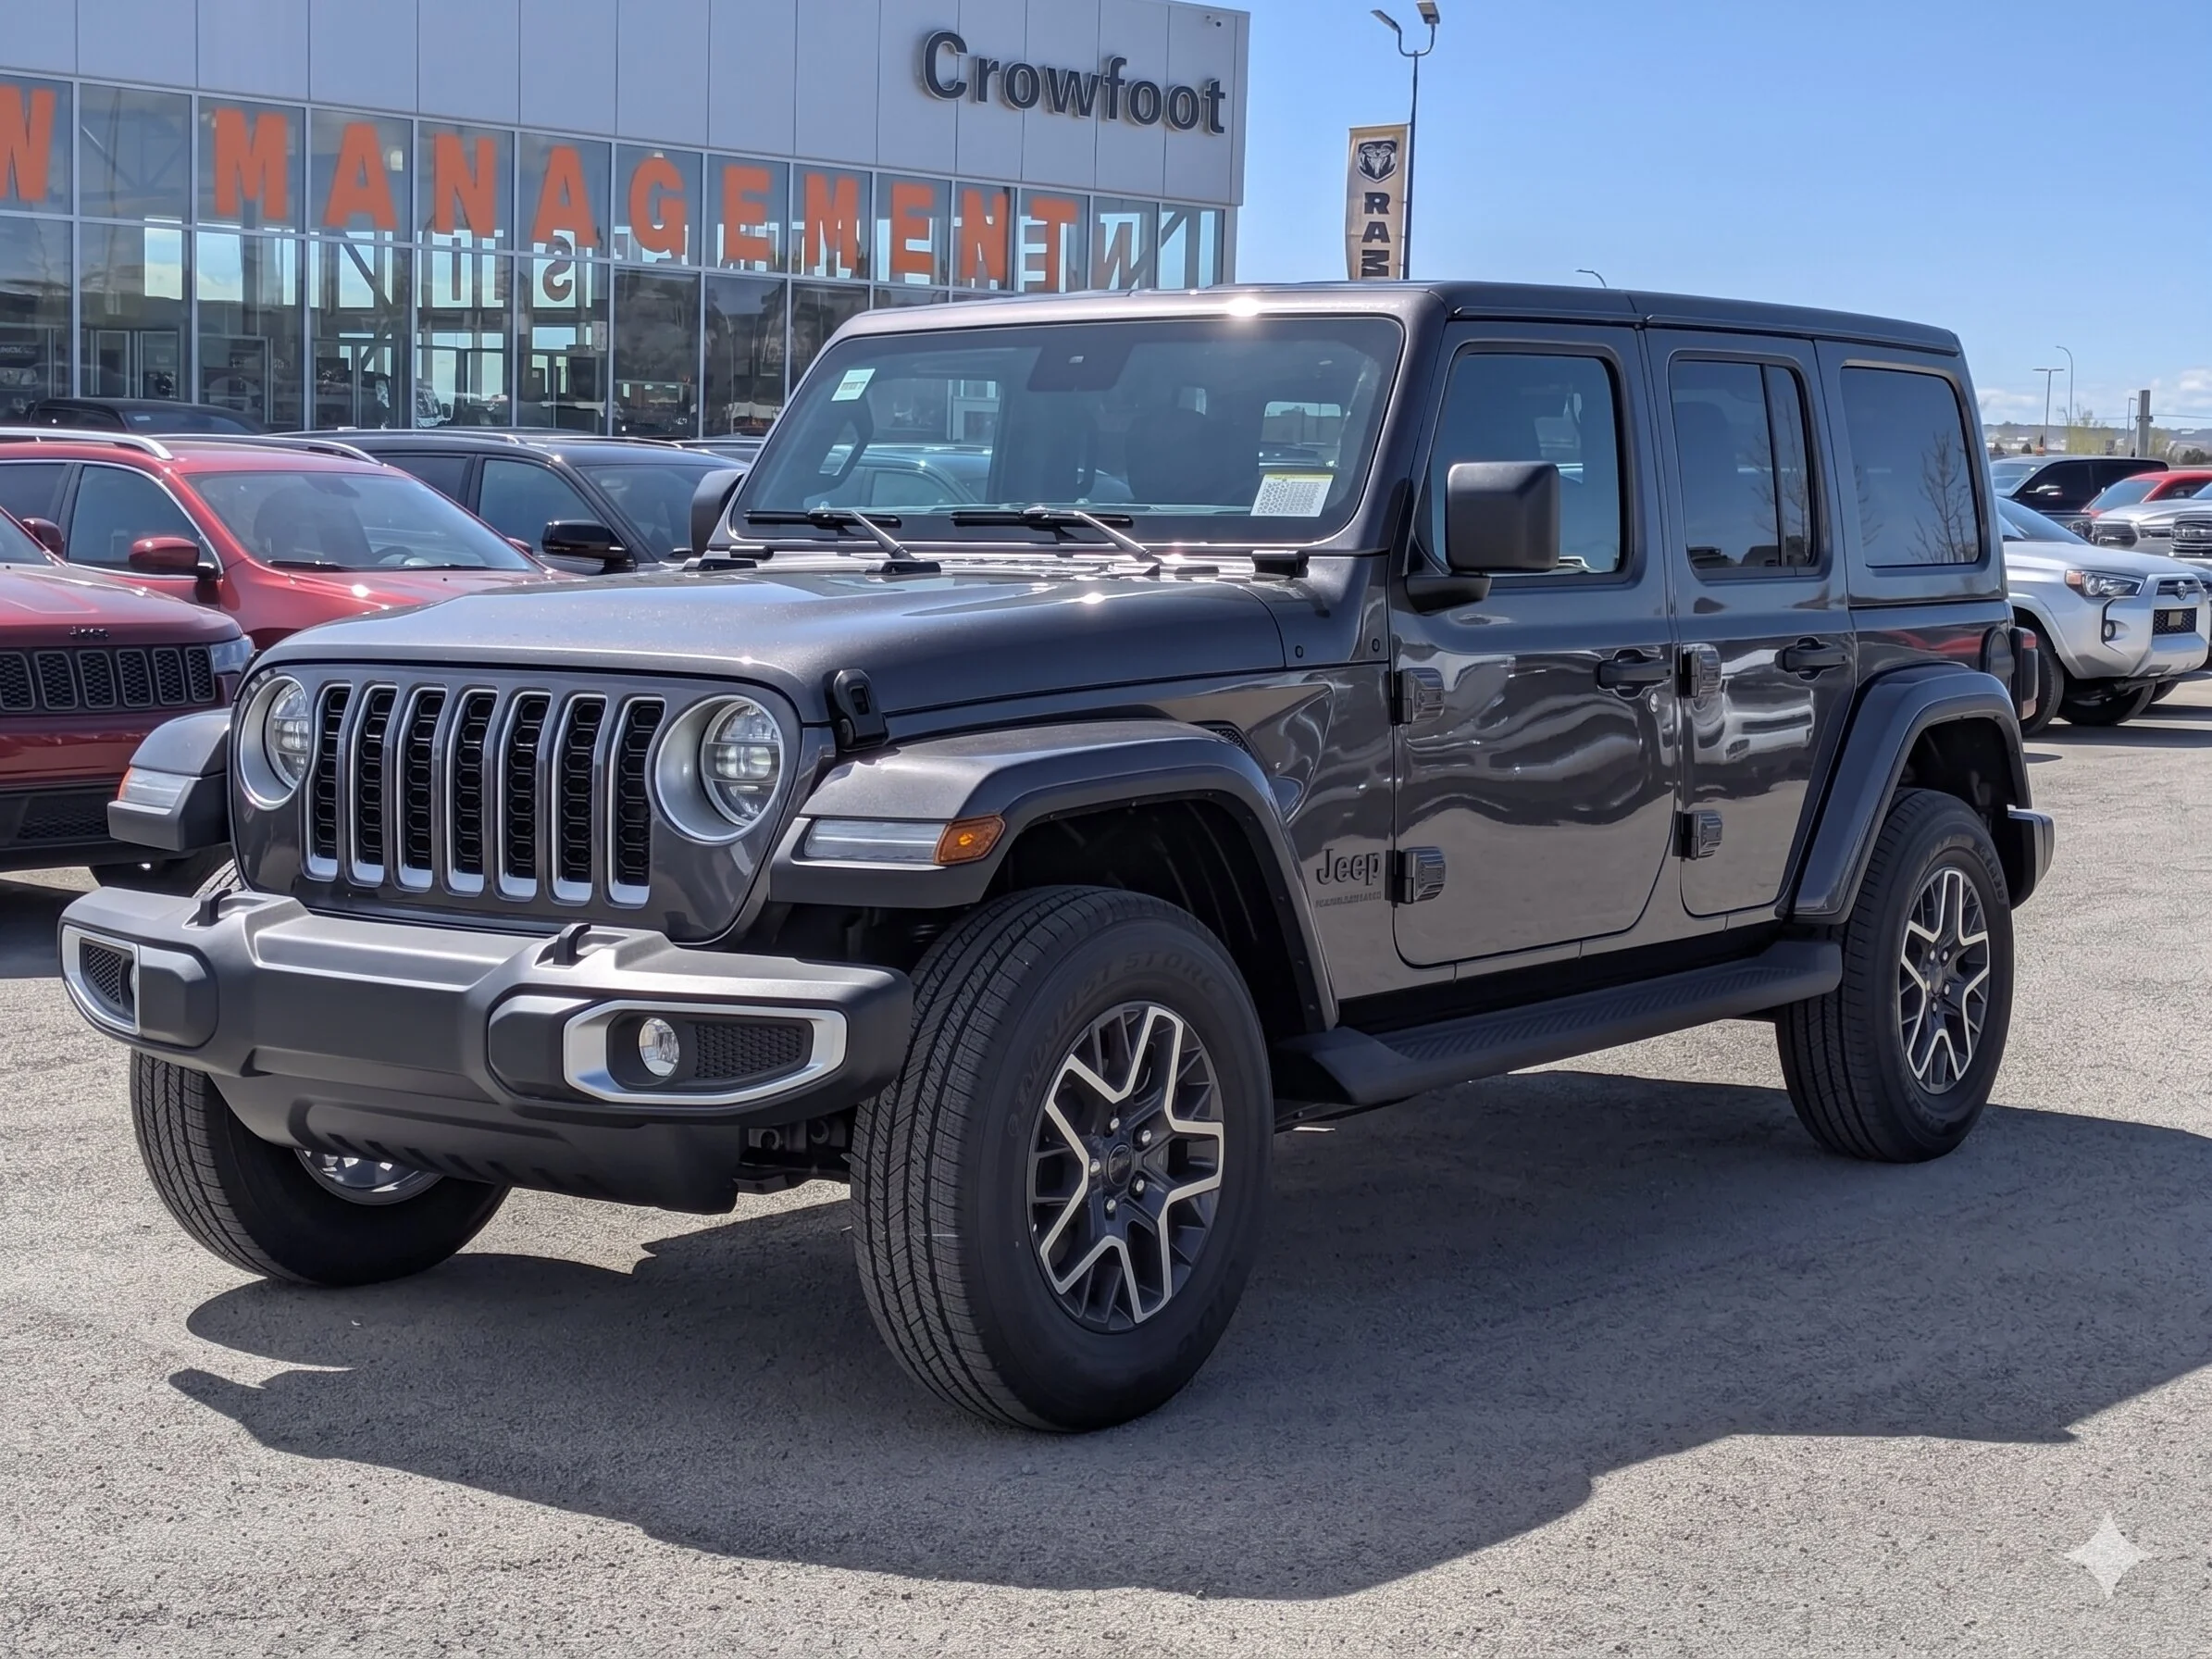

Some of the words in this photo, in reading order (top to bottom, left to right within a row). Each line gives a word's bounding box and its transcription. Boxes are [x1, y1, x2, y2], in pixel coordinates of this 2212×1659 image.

[923, 30, 1226, 135] Crowfoot
[214, 107, 1078, 293] MANAGEMENT
[1361, 192, 1390, 277] RAM
[1316, 848, 1382, 886] Jeep
